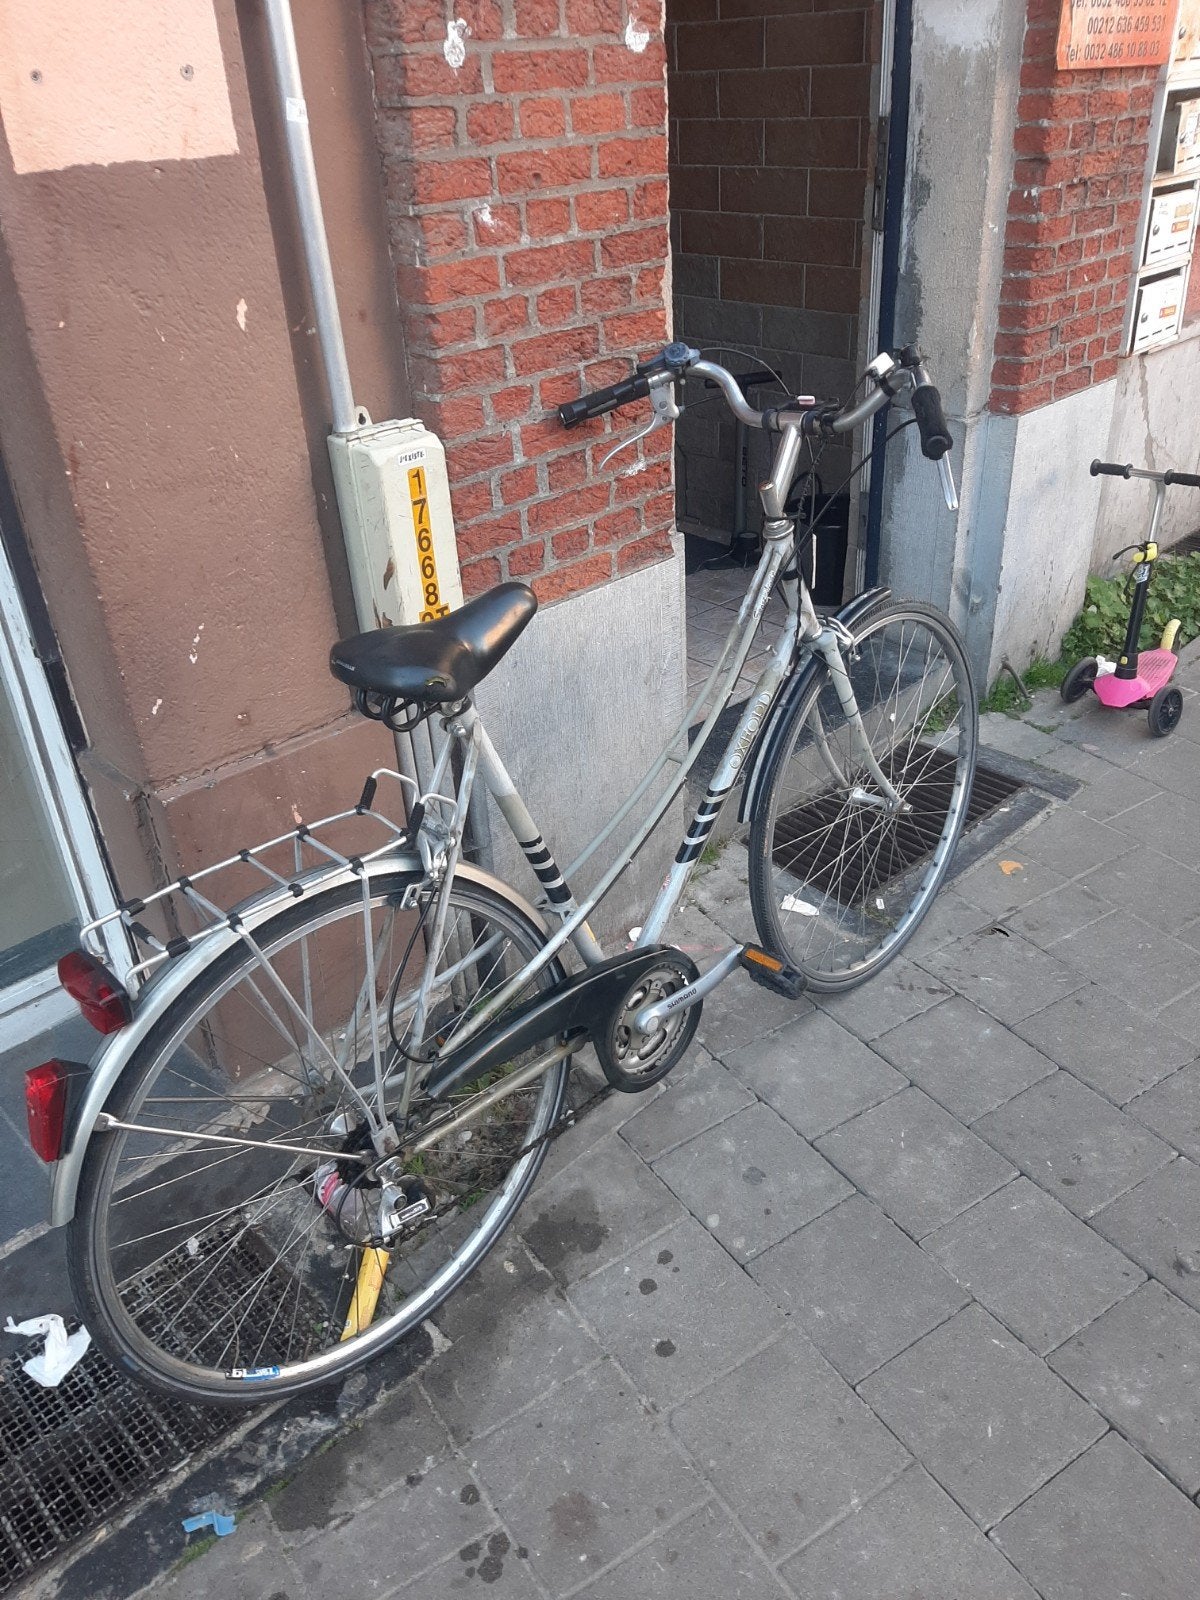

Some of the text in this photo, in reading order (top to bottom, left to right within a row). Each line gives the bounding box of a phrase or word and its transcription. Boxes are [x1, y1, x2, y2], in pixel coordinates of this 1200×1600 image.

[1087, 16, 1115, 35] 00212
[1116, 15, 1133, 33] 636
[1151, 14, 1167, 32] 531
[1066, 44, 1081, 61] Tel:
[1084, 43, 1107, 60] 0032
[1127, 42, 1137, 57] 10
[1149, 40, 1161, 56] 03
